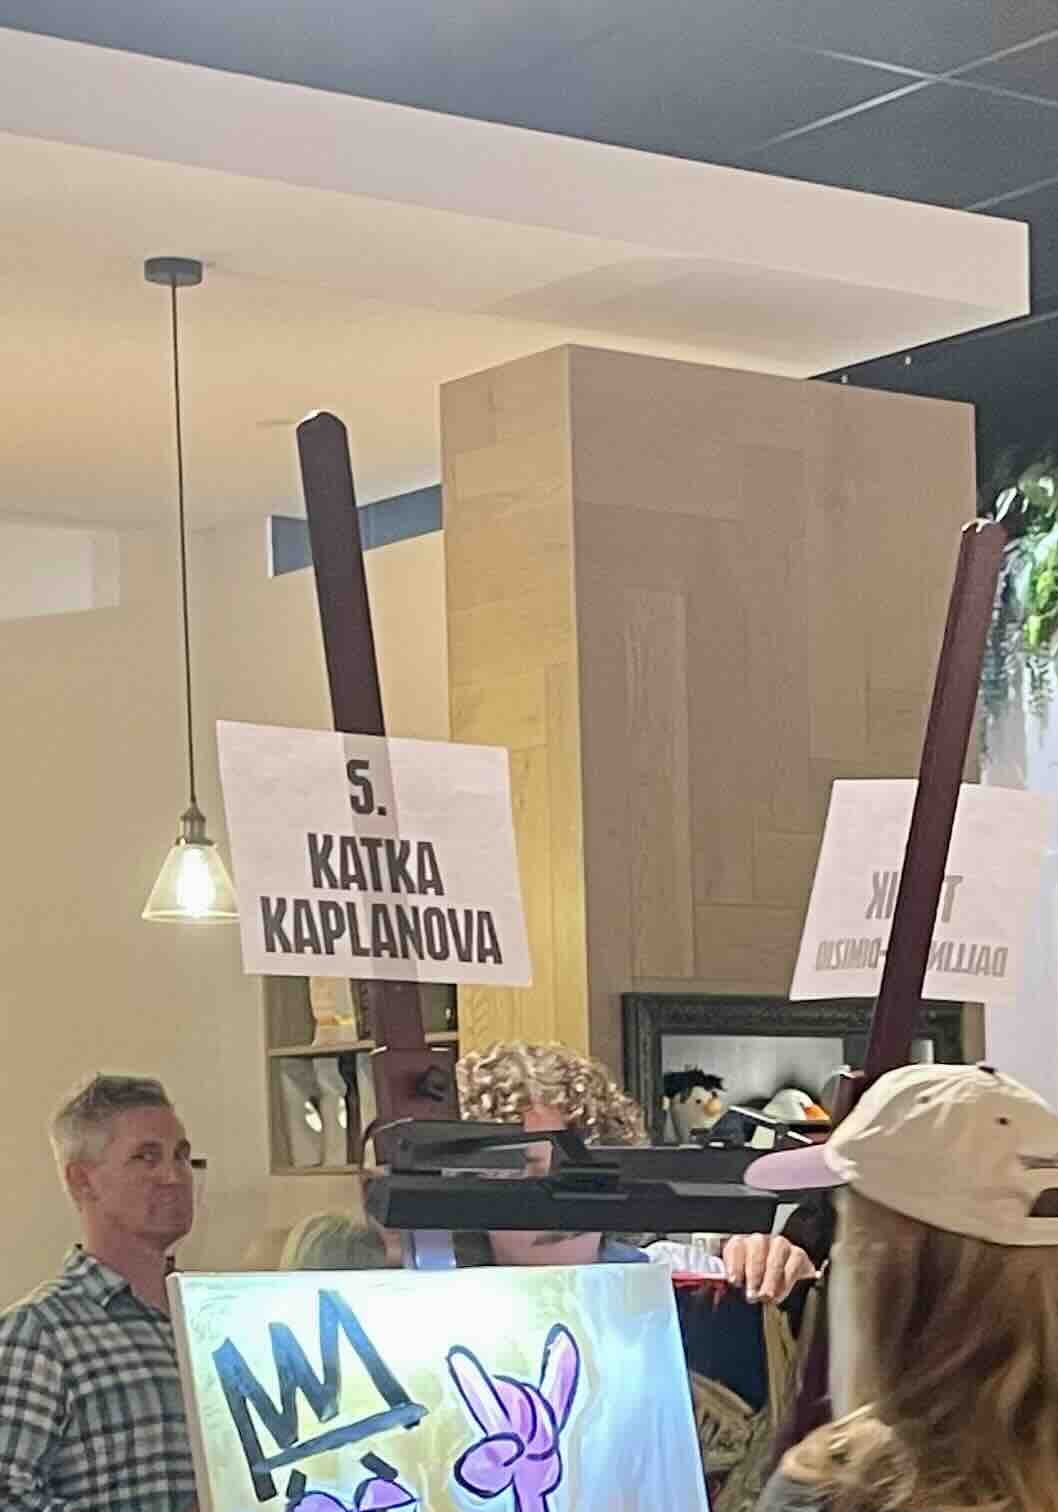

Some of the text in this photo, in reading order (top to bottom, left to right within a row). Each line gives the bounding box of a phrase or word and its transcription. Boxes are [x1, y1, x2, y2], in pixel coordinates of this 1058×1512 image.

[345, 758, 387, 816] 5.
[306, 831, 445, 897] KATKA
[259, 895, 504, 966] KAPLANOVA
